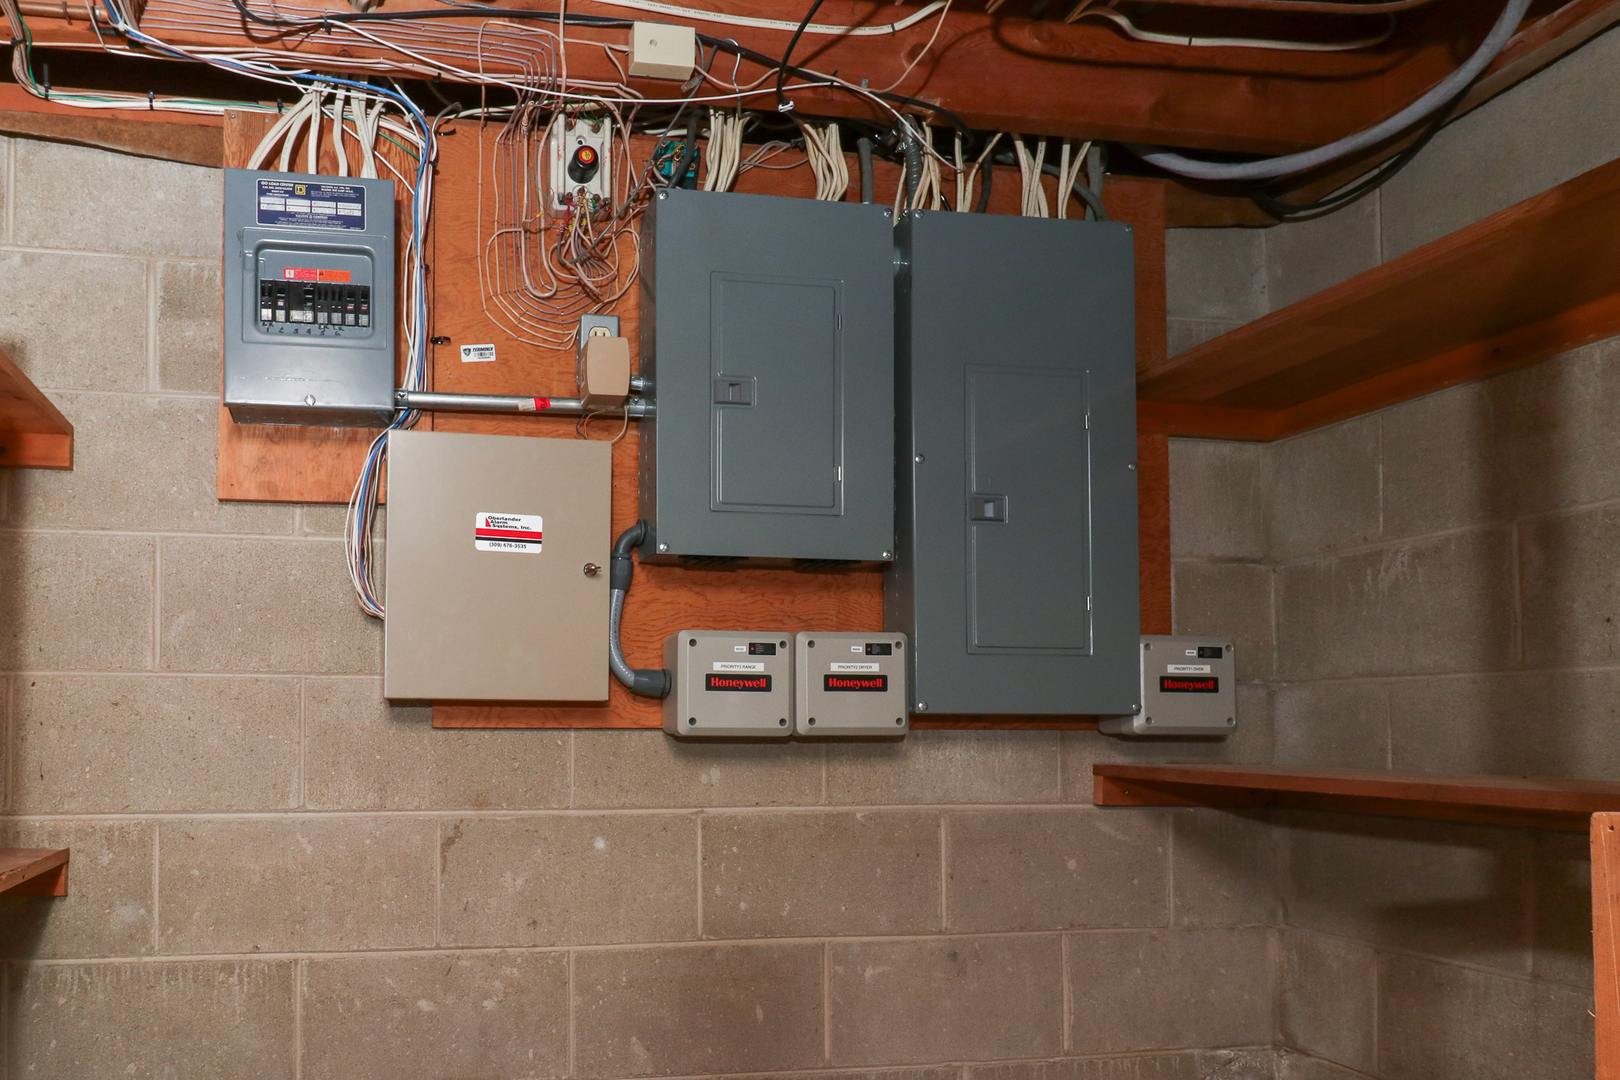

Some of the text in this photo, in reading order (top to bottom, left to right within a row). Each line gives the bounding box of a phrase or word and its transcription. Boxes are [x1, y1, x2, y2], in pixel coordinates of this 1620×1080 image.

[711, 677, 766, 689] Honeywell
[829, 678, 882, 689] Honeywell
[1164, 680, 1214, 691] Honeywell
